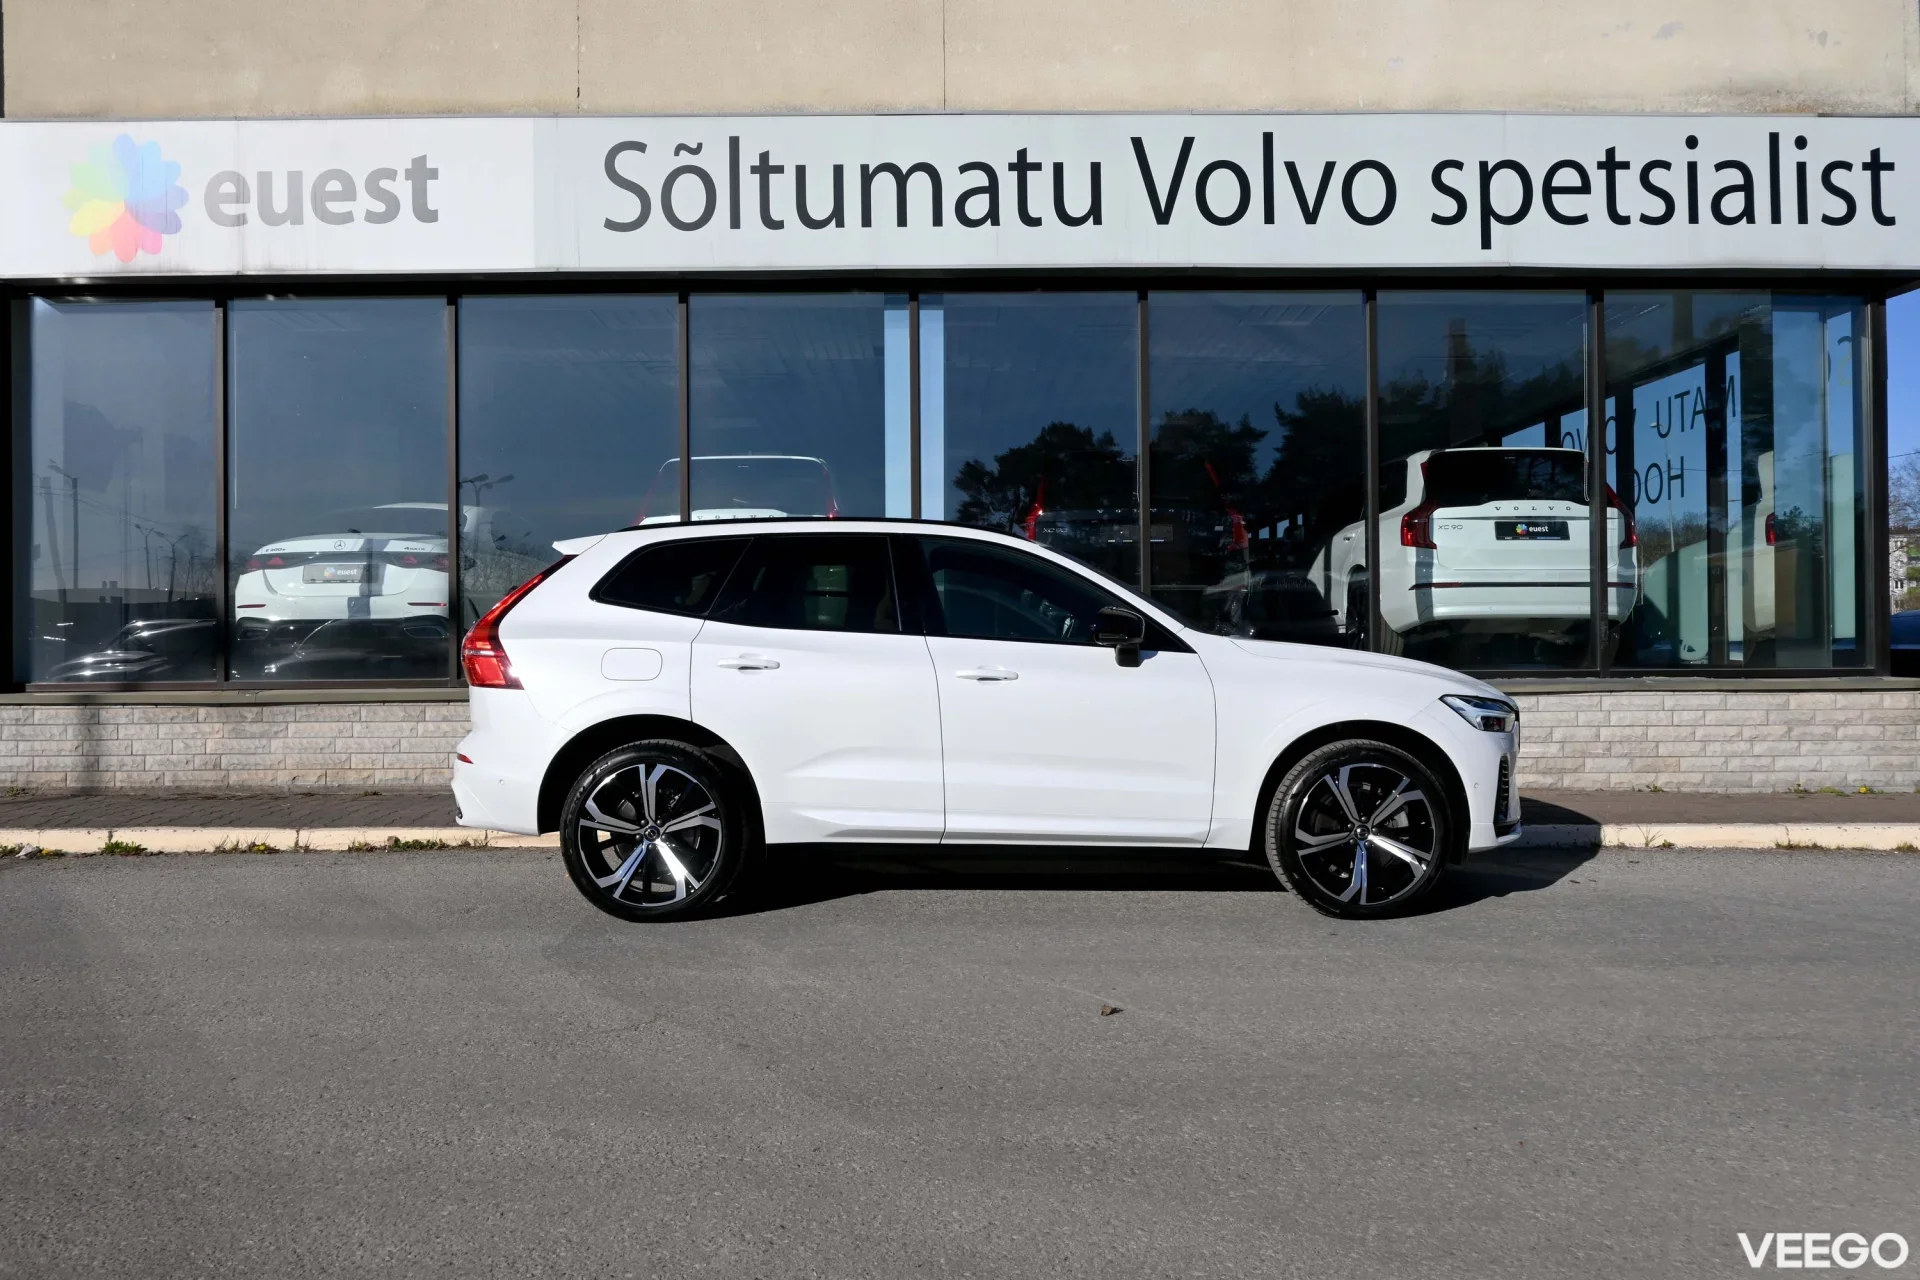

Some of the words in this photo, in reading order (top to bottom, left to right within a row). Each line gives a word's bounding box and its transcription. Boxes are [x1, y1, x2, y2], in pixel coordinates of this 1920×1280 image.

[204, 154, 439, 227] euest
[603, 136, 1102, 231] Sõltumatu
[1131, 132, 1397, 226] Volvo
[1431, 132, 1896, 249] spetsialist
